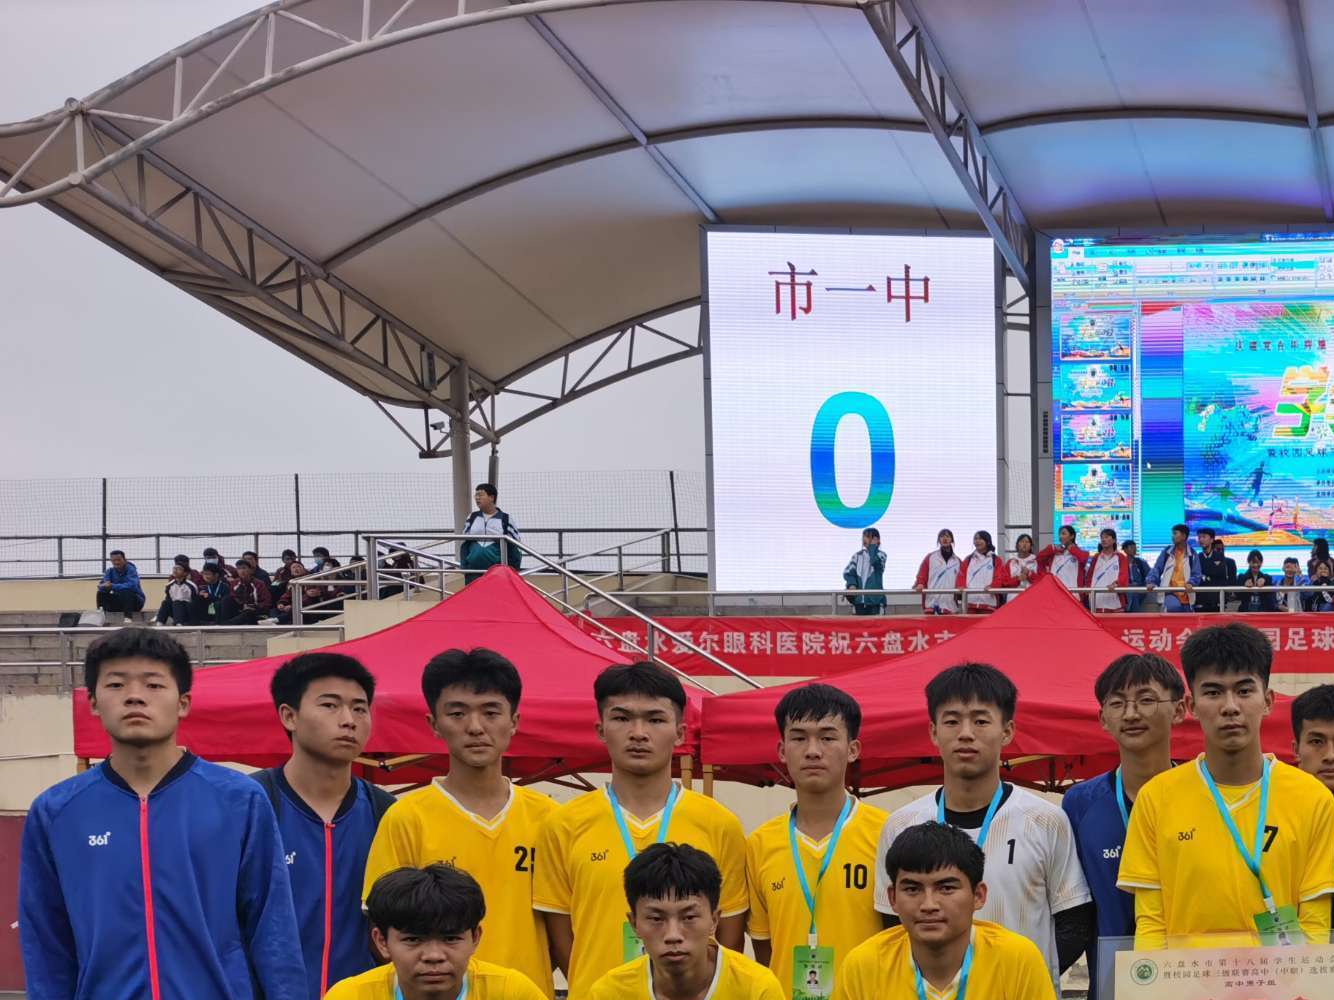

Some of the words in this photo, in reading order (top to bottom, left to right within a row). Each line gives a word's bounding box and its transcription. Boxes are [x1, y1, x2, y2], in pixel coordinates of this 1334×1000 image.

[768, 261, 930, 323] 市一中
[810, 391, 895, 529] 0
[1007, 839, 1016, 864] 1
[1263, 825, 1279, 853] 7
[843, 863, 868, 890] 10
